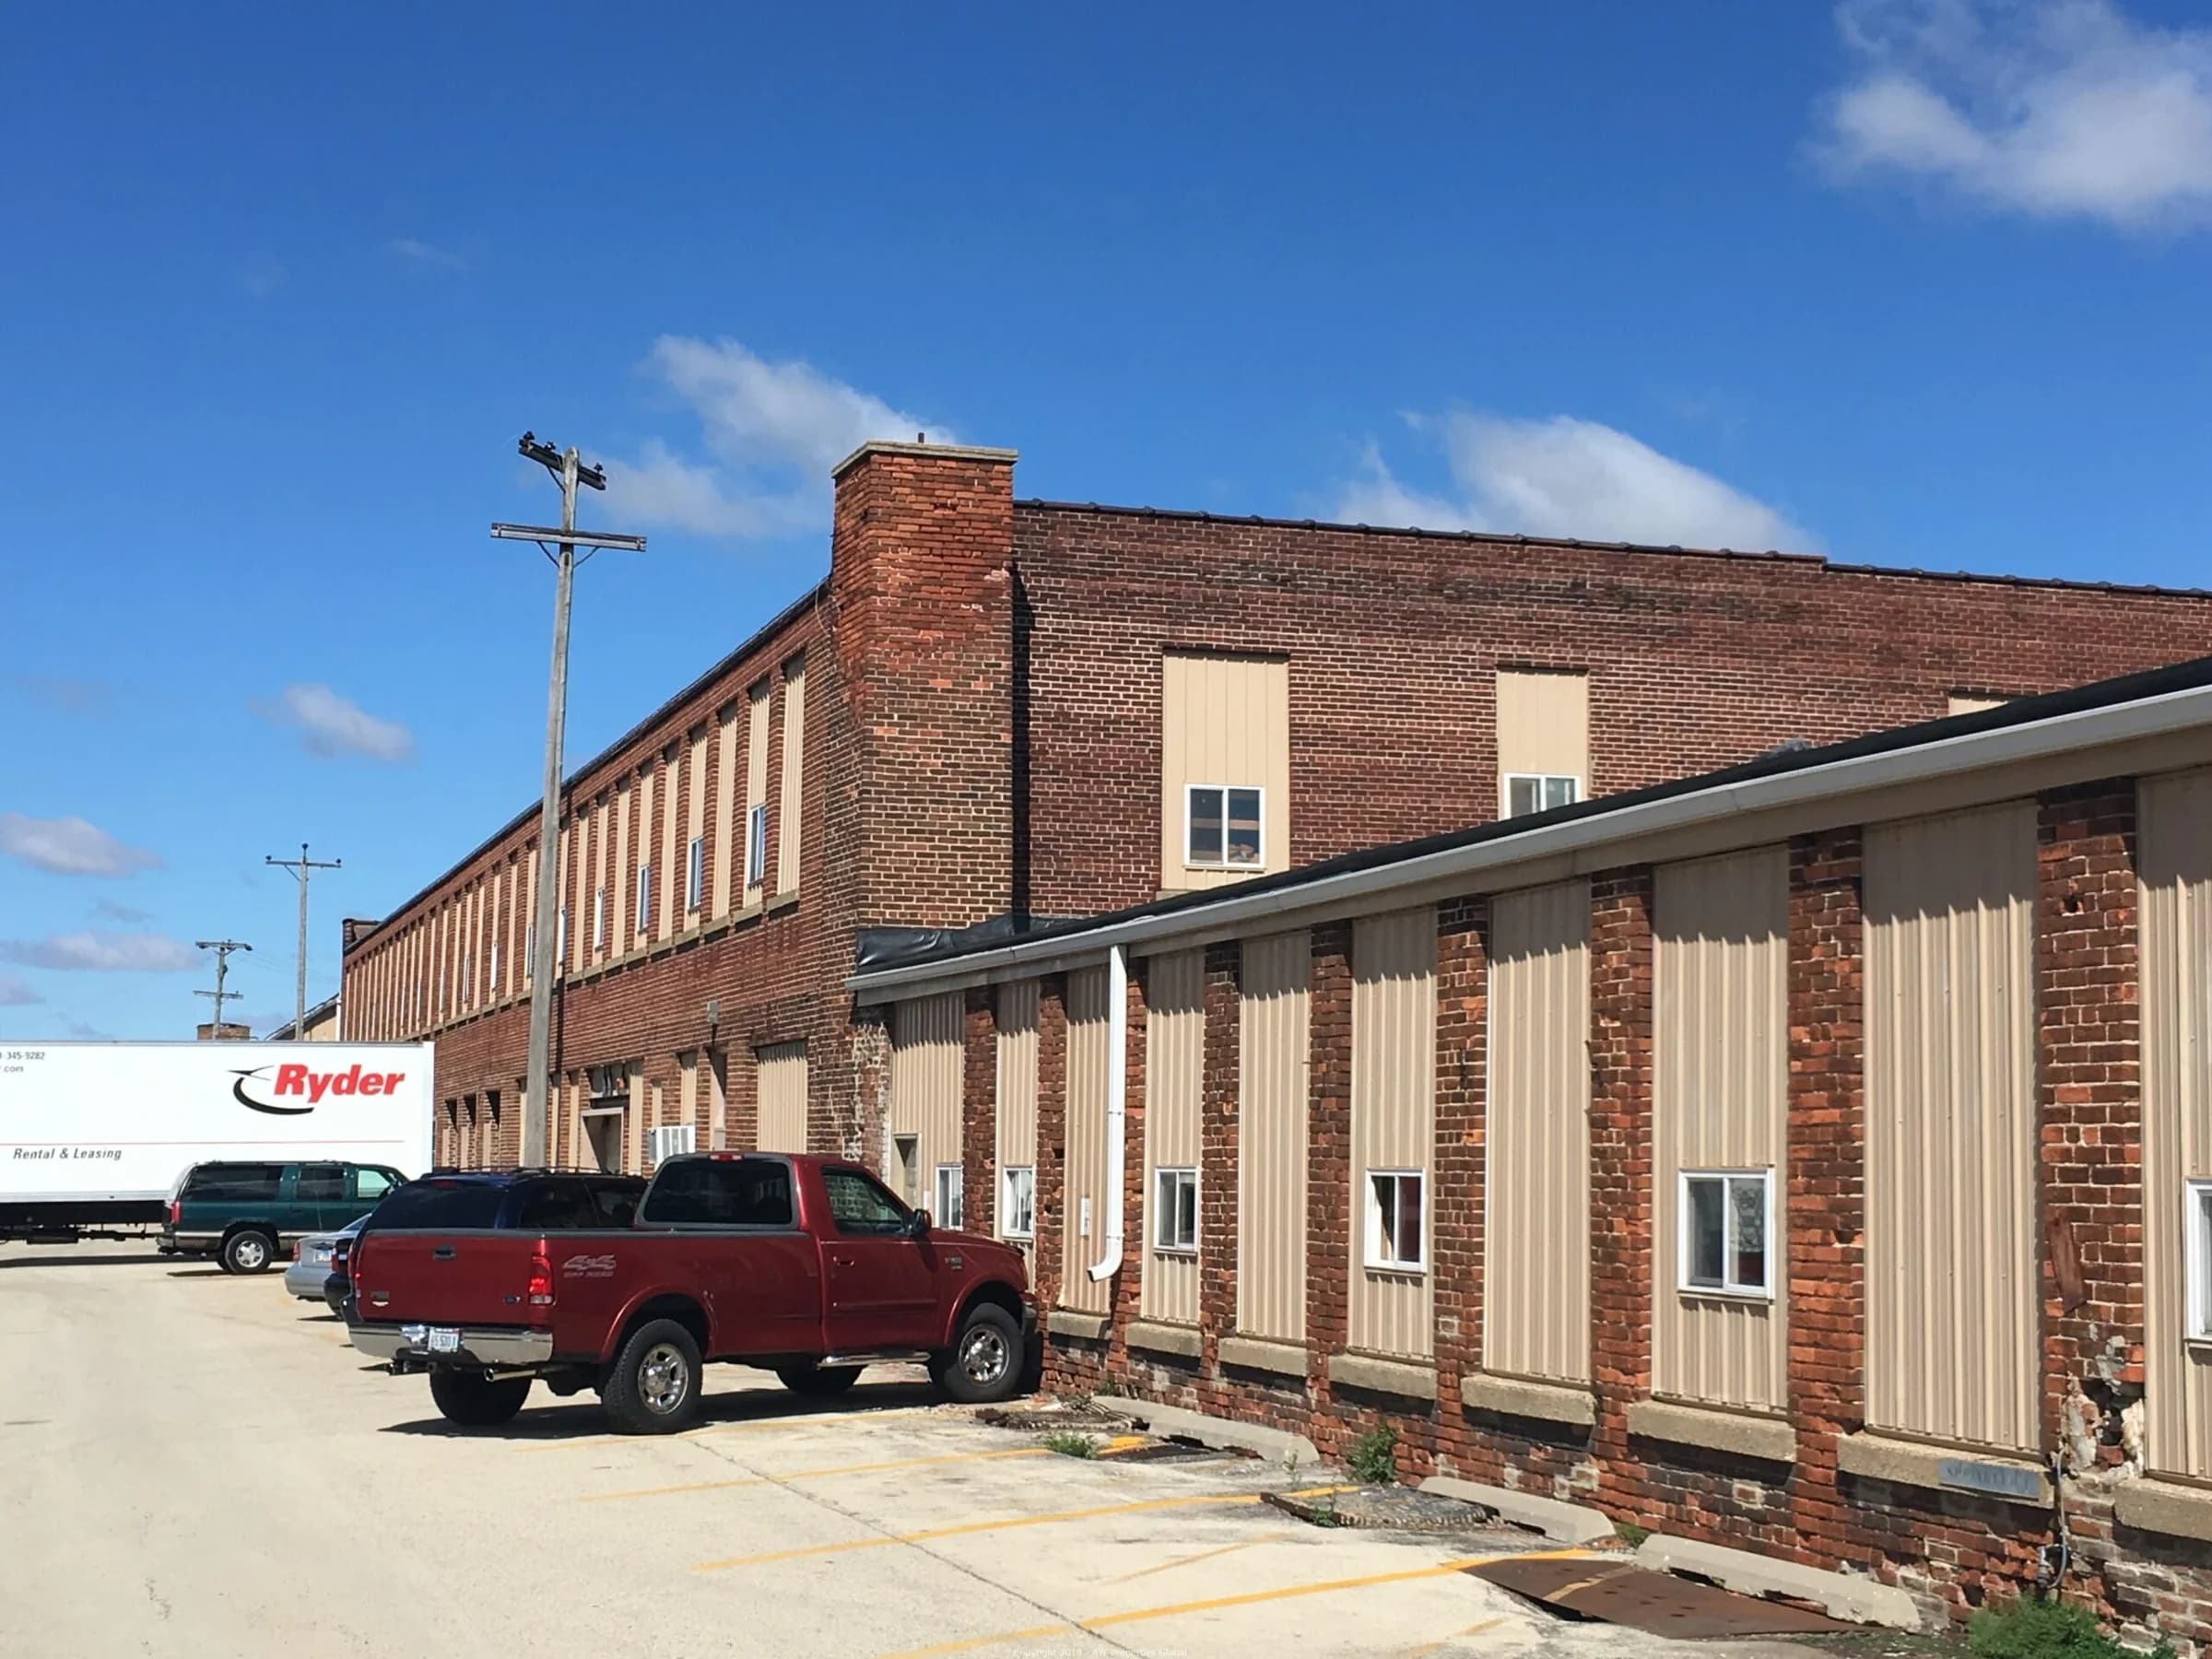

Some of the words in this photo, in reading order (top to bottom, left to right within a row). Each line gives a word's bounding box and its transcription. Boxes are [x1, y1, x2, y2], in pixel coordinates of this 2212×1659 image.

[274, 1064, 406, 1103] Ryder
[13, 1147, 55, 1159] Rental
[59, 1147, 69, 1159] &
[73, 1147, 122, 1161] Leasing
